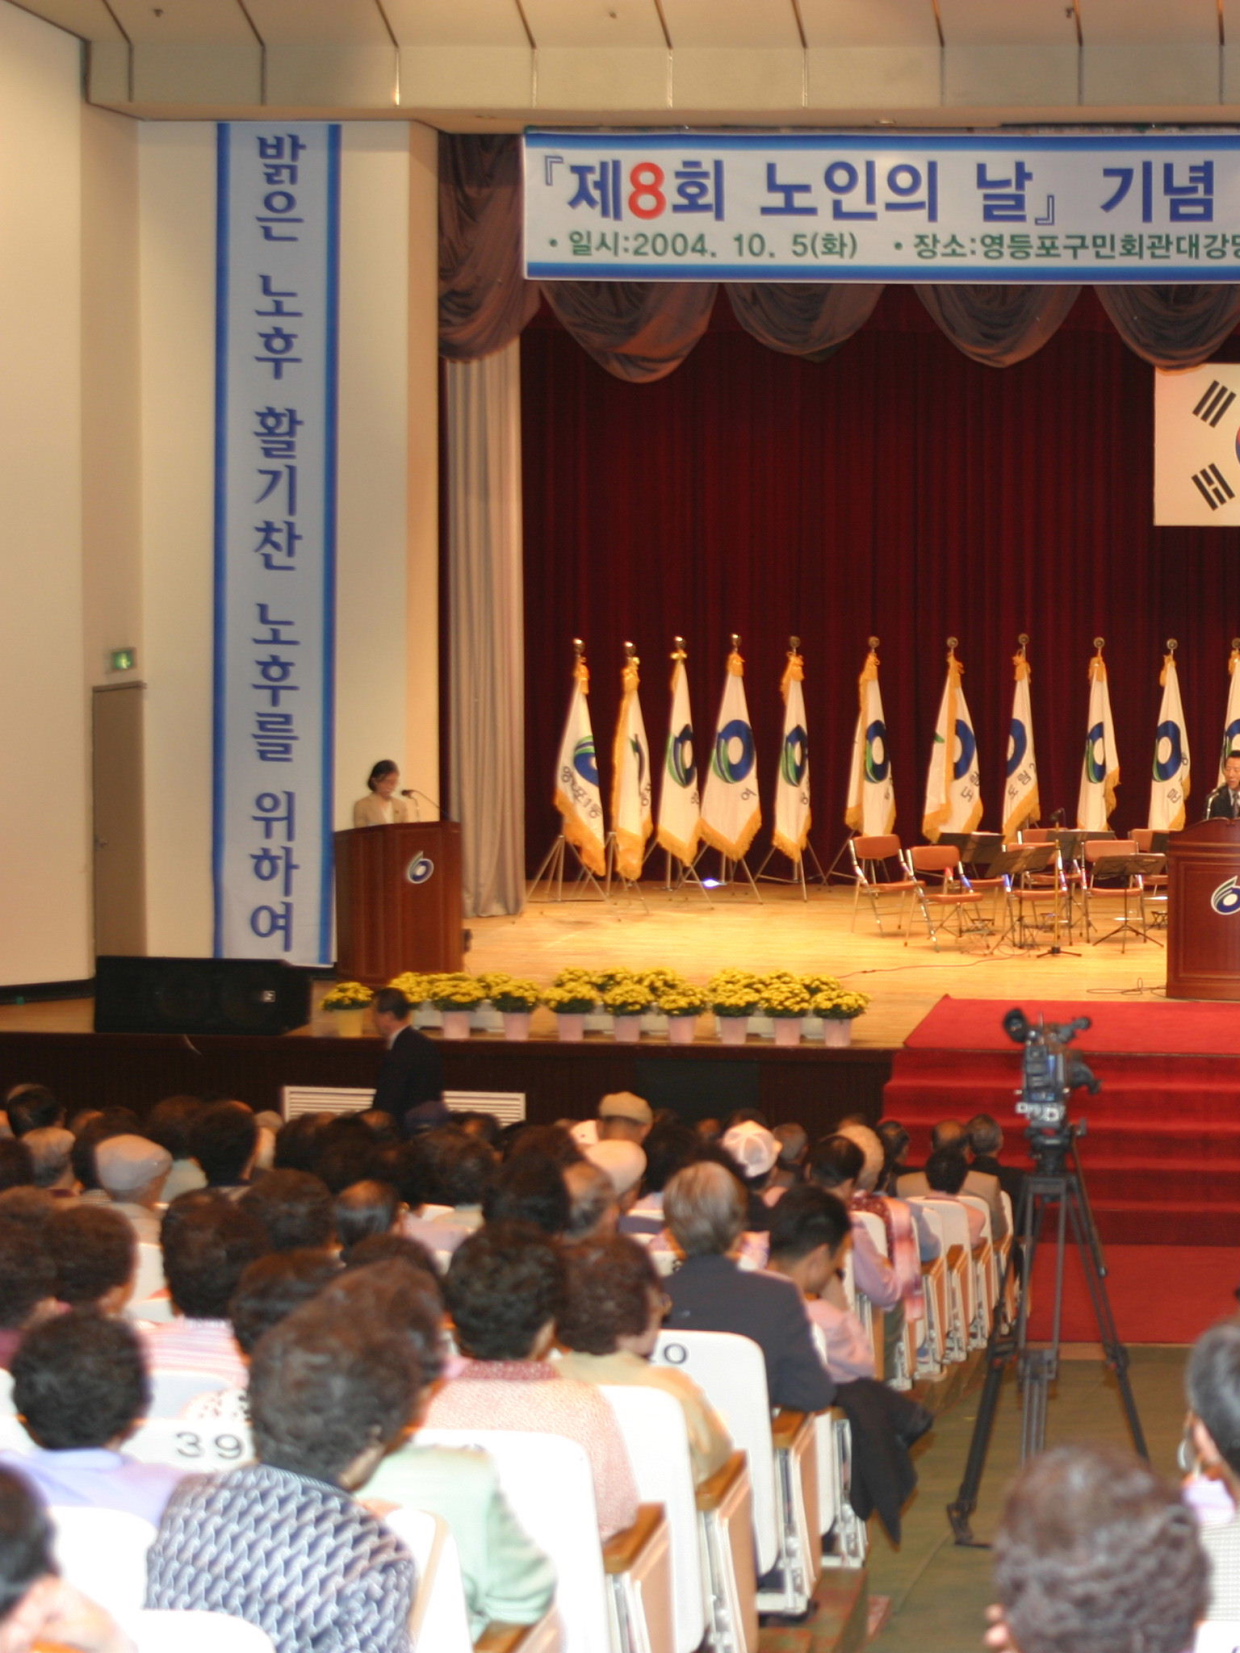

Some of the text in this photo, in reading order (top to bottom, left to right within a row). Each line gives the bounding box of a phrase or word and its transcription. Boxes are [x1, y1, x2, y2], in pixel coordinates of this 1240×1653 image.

[760, 159, 939, 223] 노인의
[1100, 160, 1215, 223] 기념
[249, 134, 307, 953] 밝은 노후 활기찬 노후를 위하여
[175, 1430, 244, 1461] 39
